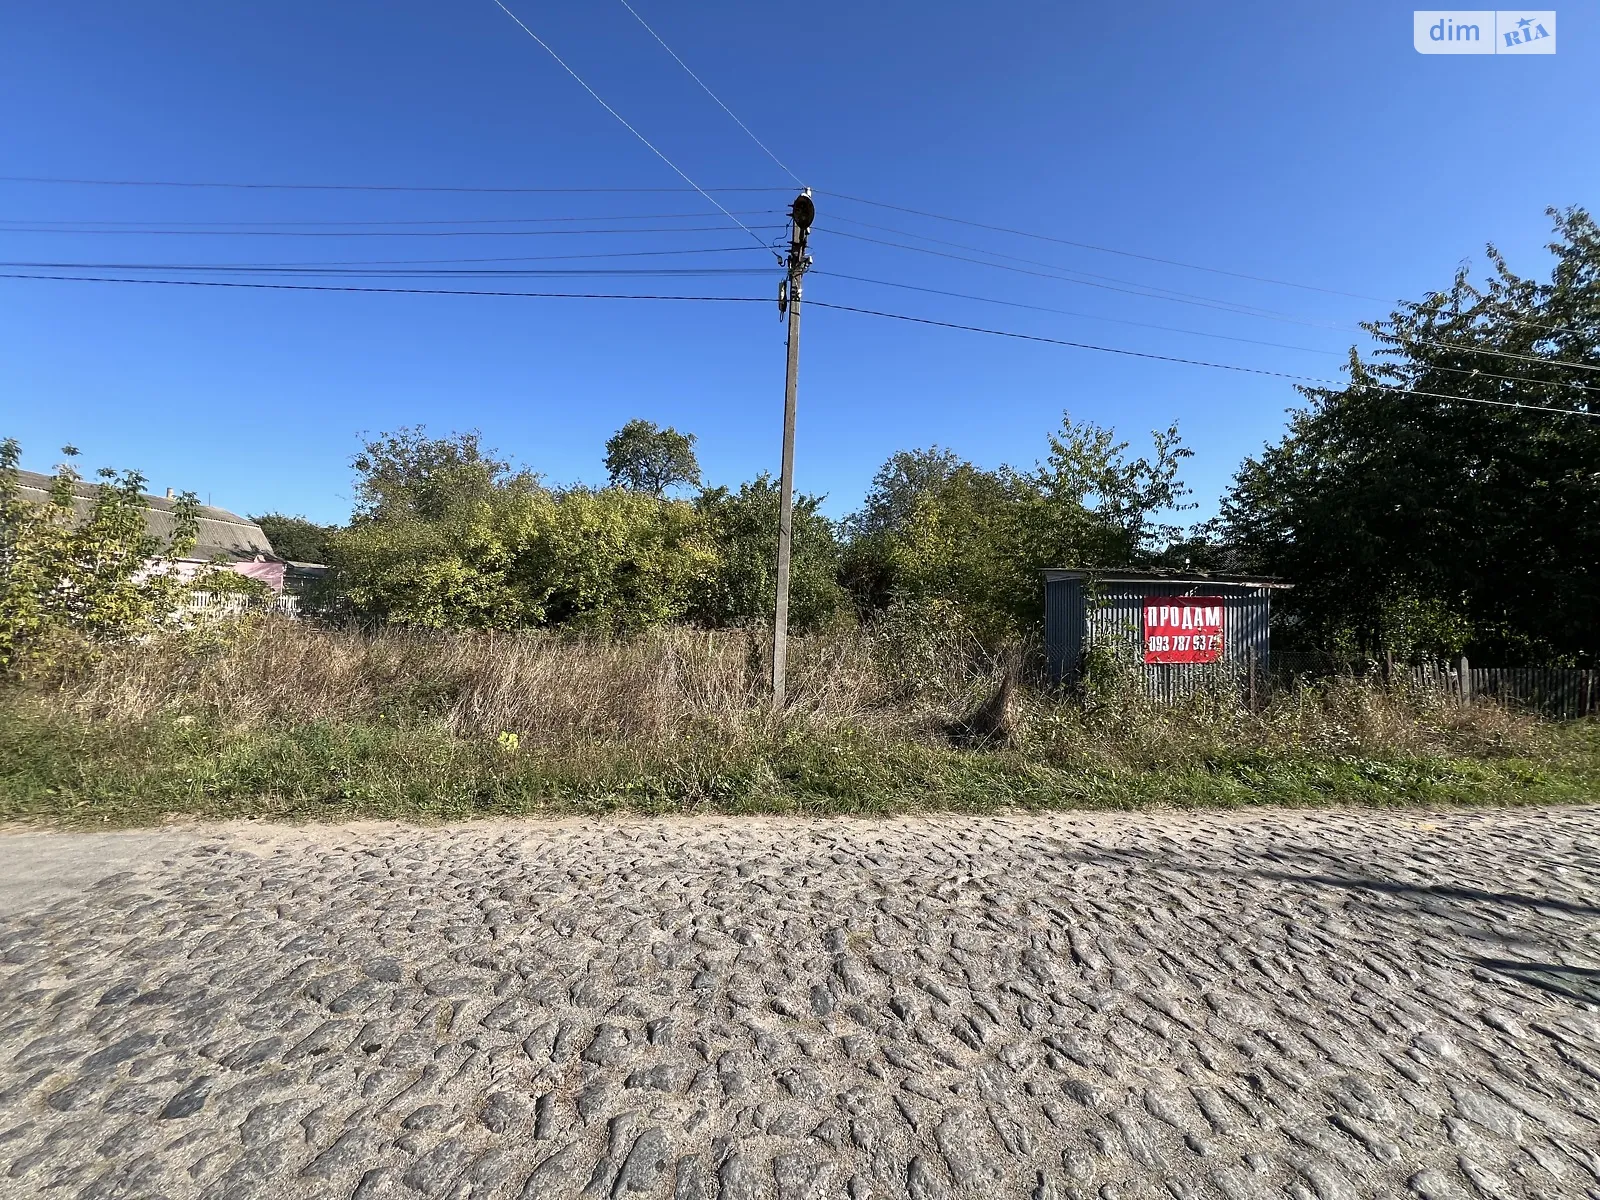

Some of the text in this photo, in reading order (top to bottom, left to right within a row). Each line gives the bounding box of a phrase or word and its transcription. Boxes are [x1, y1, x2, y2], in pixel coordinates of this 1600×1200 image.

[1147, 606, 1220, 629] ПРОДАМ
[1149, 636, 1170, 652] 093
[1172, 635, 1191, 651] 787
